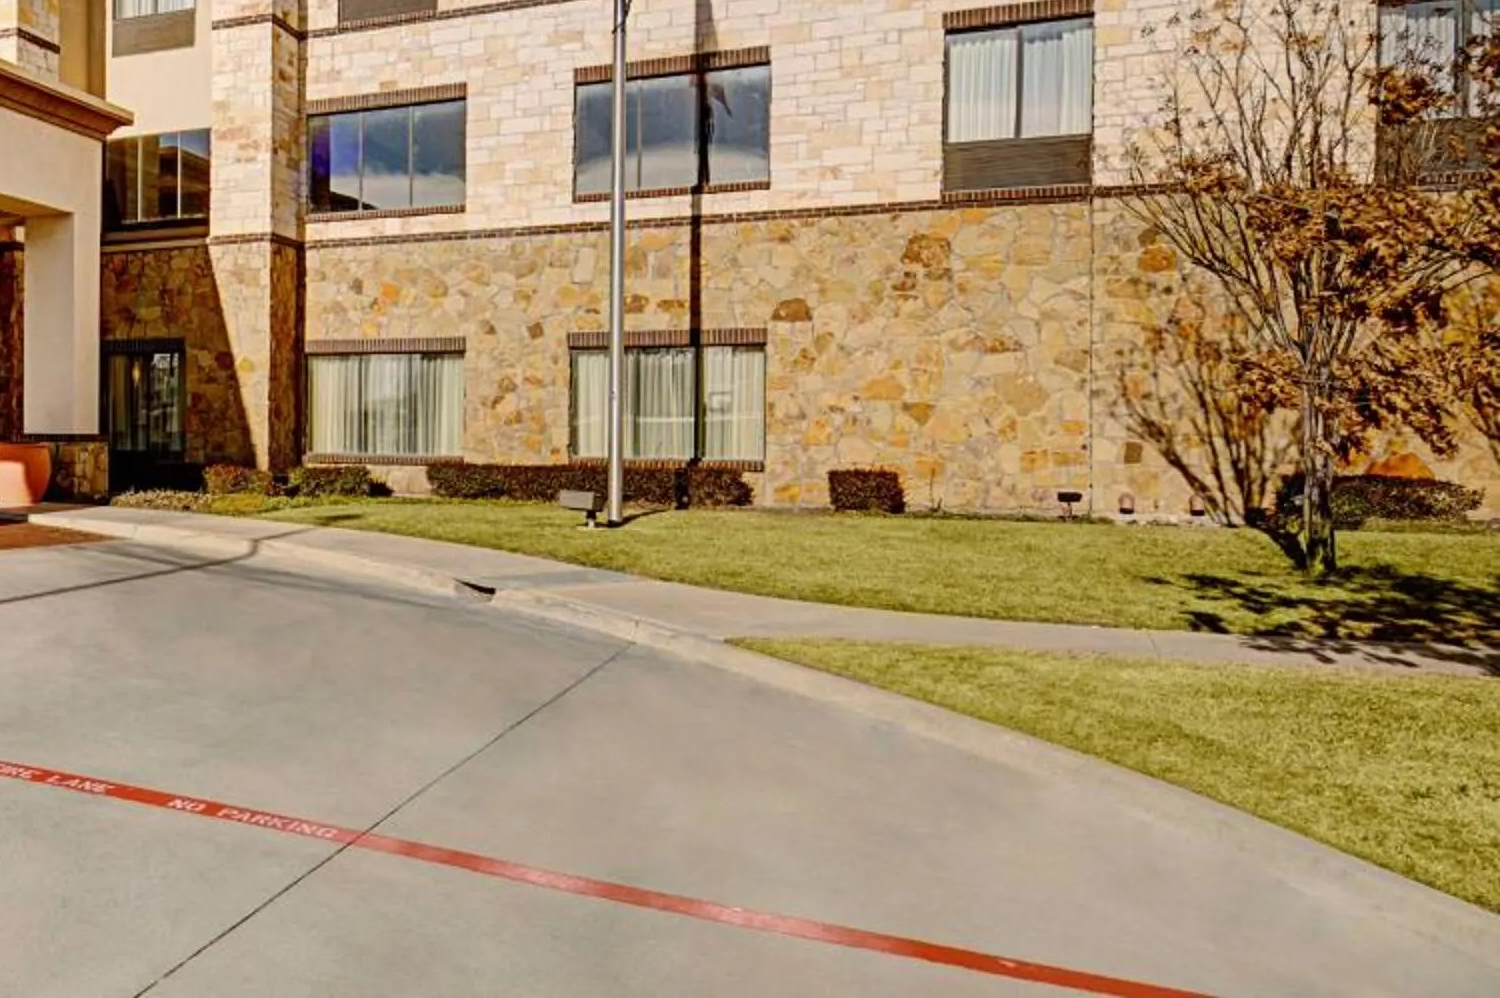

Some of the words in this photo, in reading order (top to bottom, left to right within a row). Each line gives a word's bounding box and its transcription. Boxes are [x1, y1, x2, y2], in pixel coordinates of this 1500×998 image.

[47, 774, 114, 794] LANE
[167, 797, 206, 811] NO
[217, 807, 338, 838] PARKING
